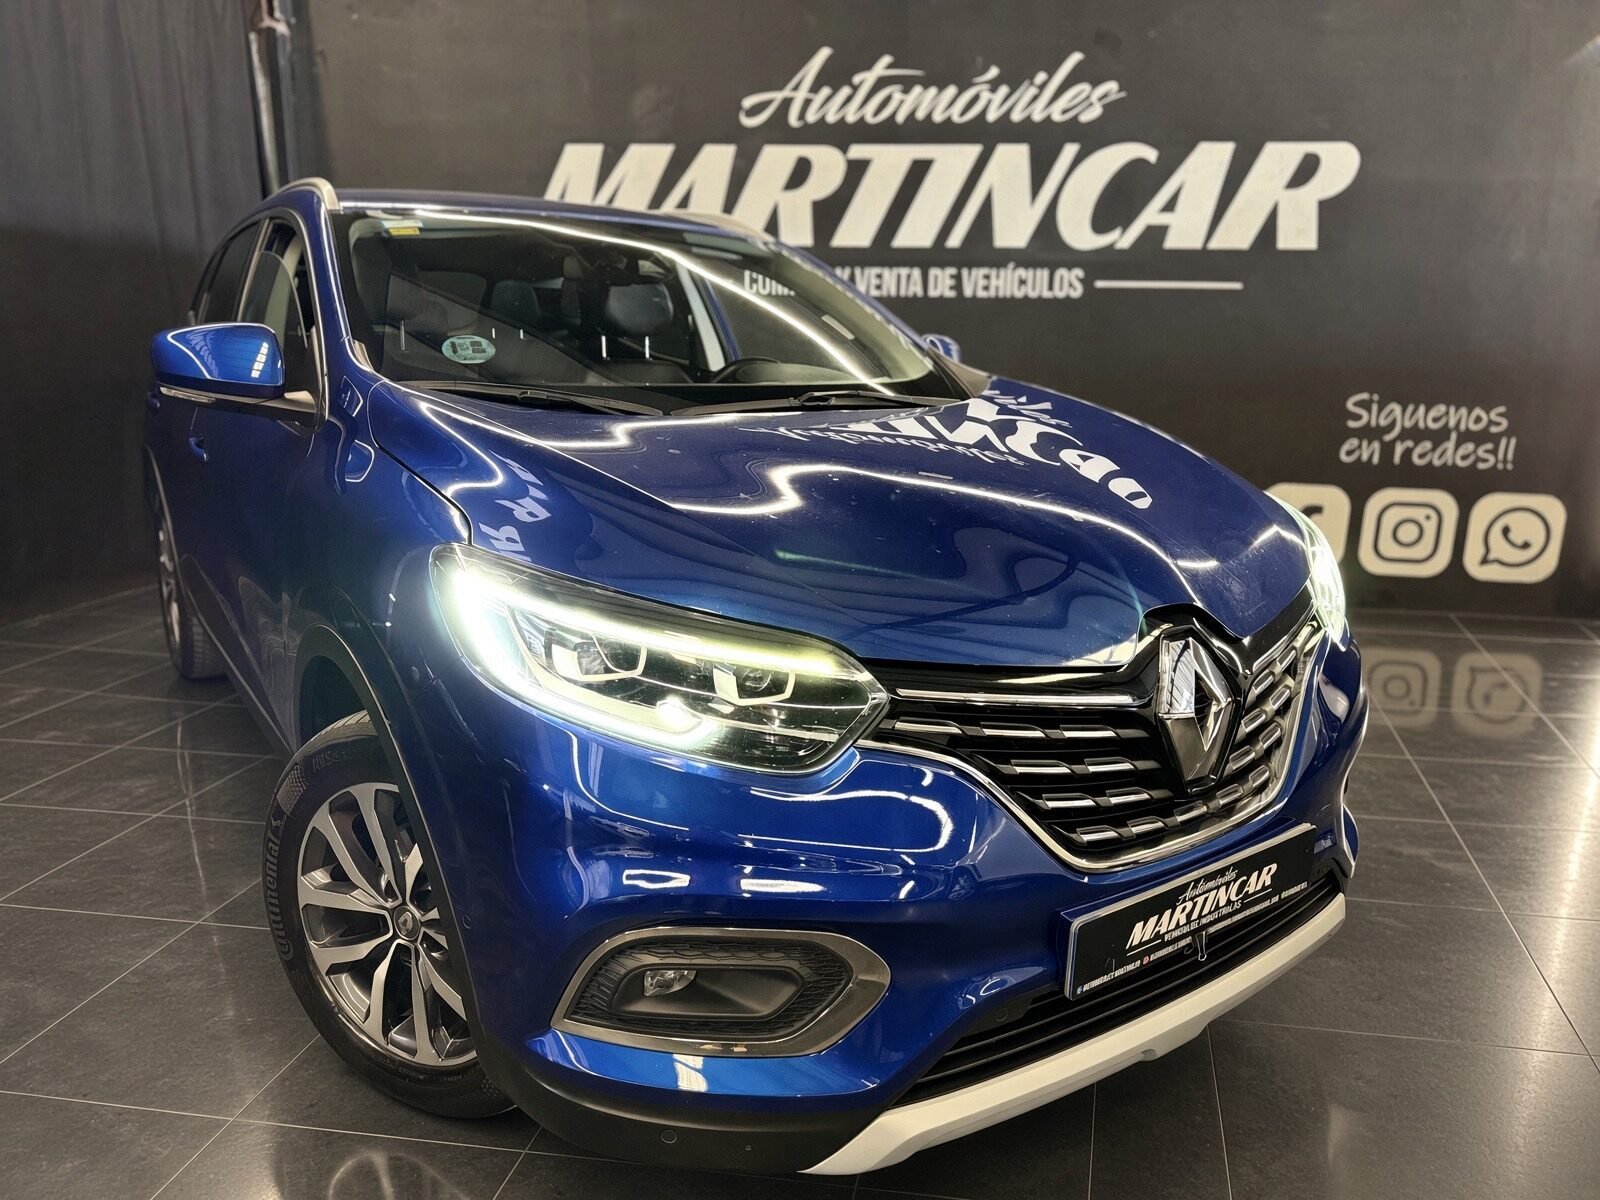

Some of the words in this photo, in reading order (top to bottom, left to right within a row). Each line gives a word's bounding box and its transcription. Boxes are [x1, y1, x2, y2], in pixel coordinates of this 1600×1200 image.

[738, 45, 1127, 128] Automóviles
[542, 140, 1361, 251] MARTINCAR
[854, 266, 924, 298] VENTA
[927, 266, 958, 298] DE
[961, 261, 1086, 299] VEHÍCULOS
[1339, 436, 1381, 466] en
[1393, 429, 1517, 471] redes!!
[1345, 391, 1509, 442] Siguenos
[1126, 862, 1278, 950] MARTINCAR
